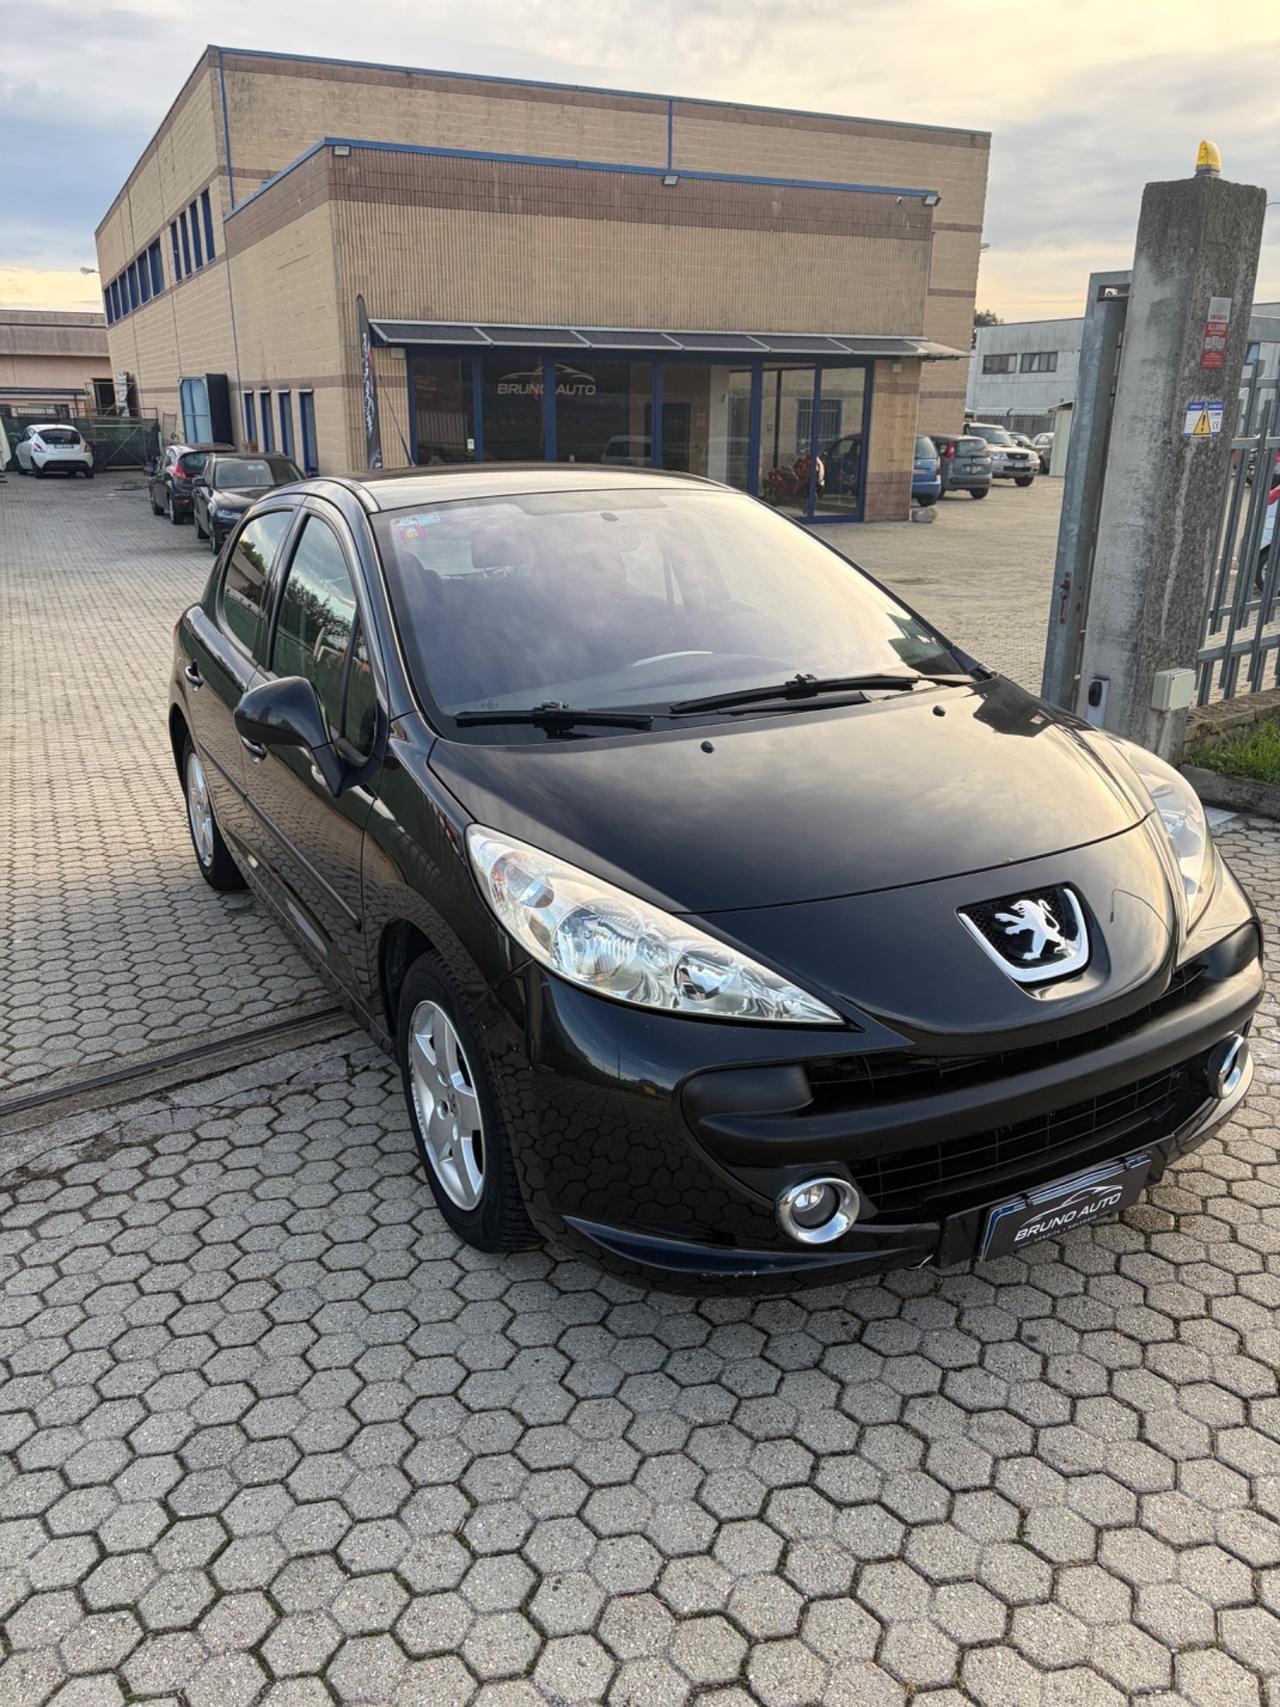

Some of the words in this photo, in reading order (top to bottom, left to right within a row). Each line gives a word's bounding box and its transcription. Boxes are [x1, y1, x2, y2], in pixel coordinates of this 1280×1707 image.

[555, 383, 597, 396] AUTO
[1014, 1210, 1077, 1242] BRUNO
[1076, 1192, 1122, 1218] AUTO
